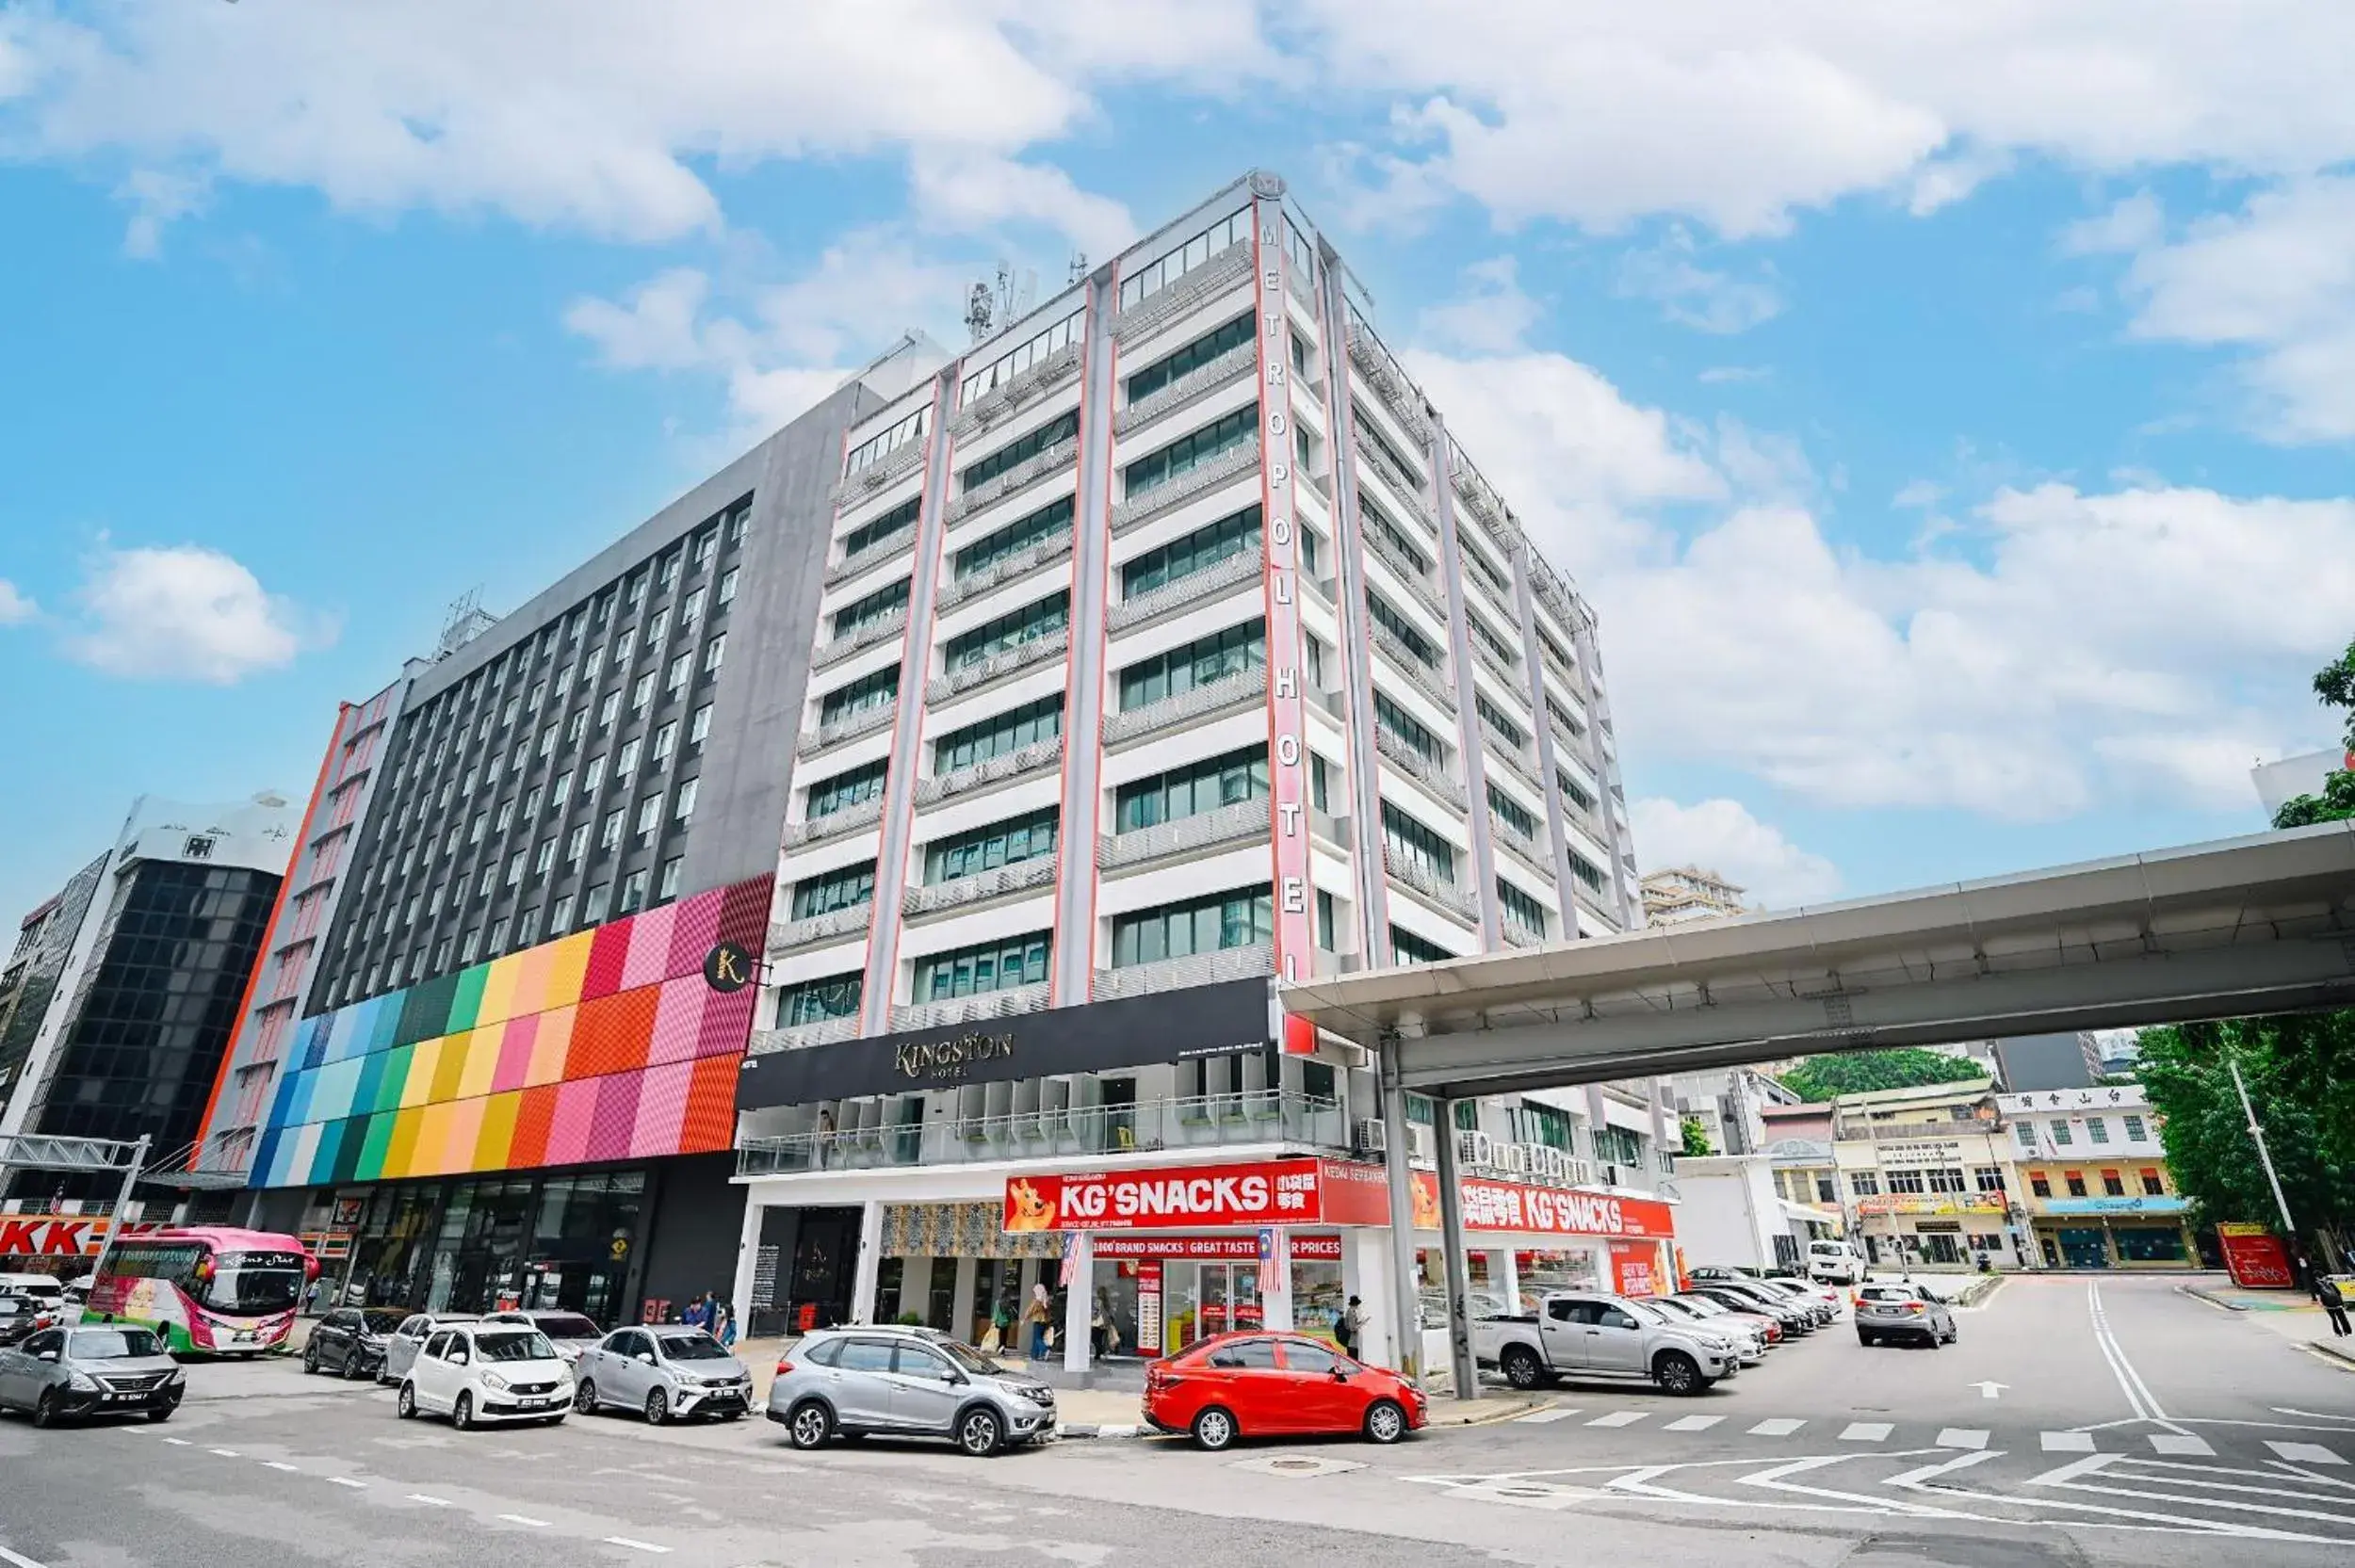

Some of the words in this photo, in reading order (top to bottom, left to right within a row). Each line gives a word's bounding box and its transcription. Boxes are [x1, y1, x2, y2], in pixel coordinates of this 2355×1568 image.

[1262, 224, 1291, 605] METROPOL
[717, 946, 744, 983] K
[895, 1030, 1014, 1077] KINGSTON
[930, 1066, 967, 1079] HOTEL
[1148, 1242, 1184, 1253] SNACKS
[1190, 1242, 1223, 1253] GREAT
[1225, 1242, 1255, 1253] TASTE
[1301, 1242, 1340, 1253] PRICES
